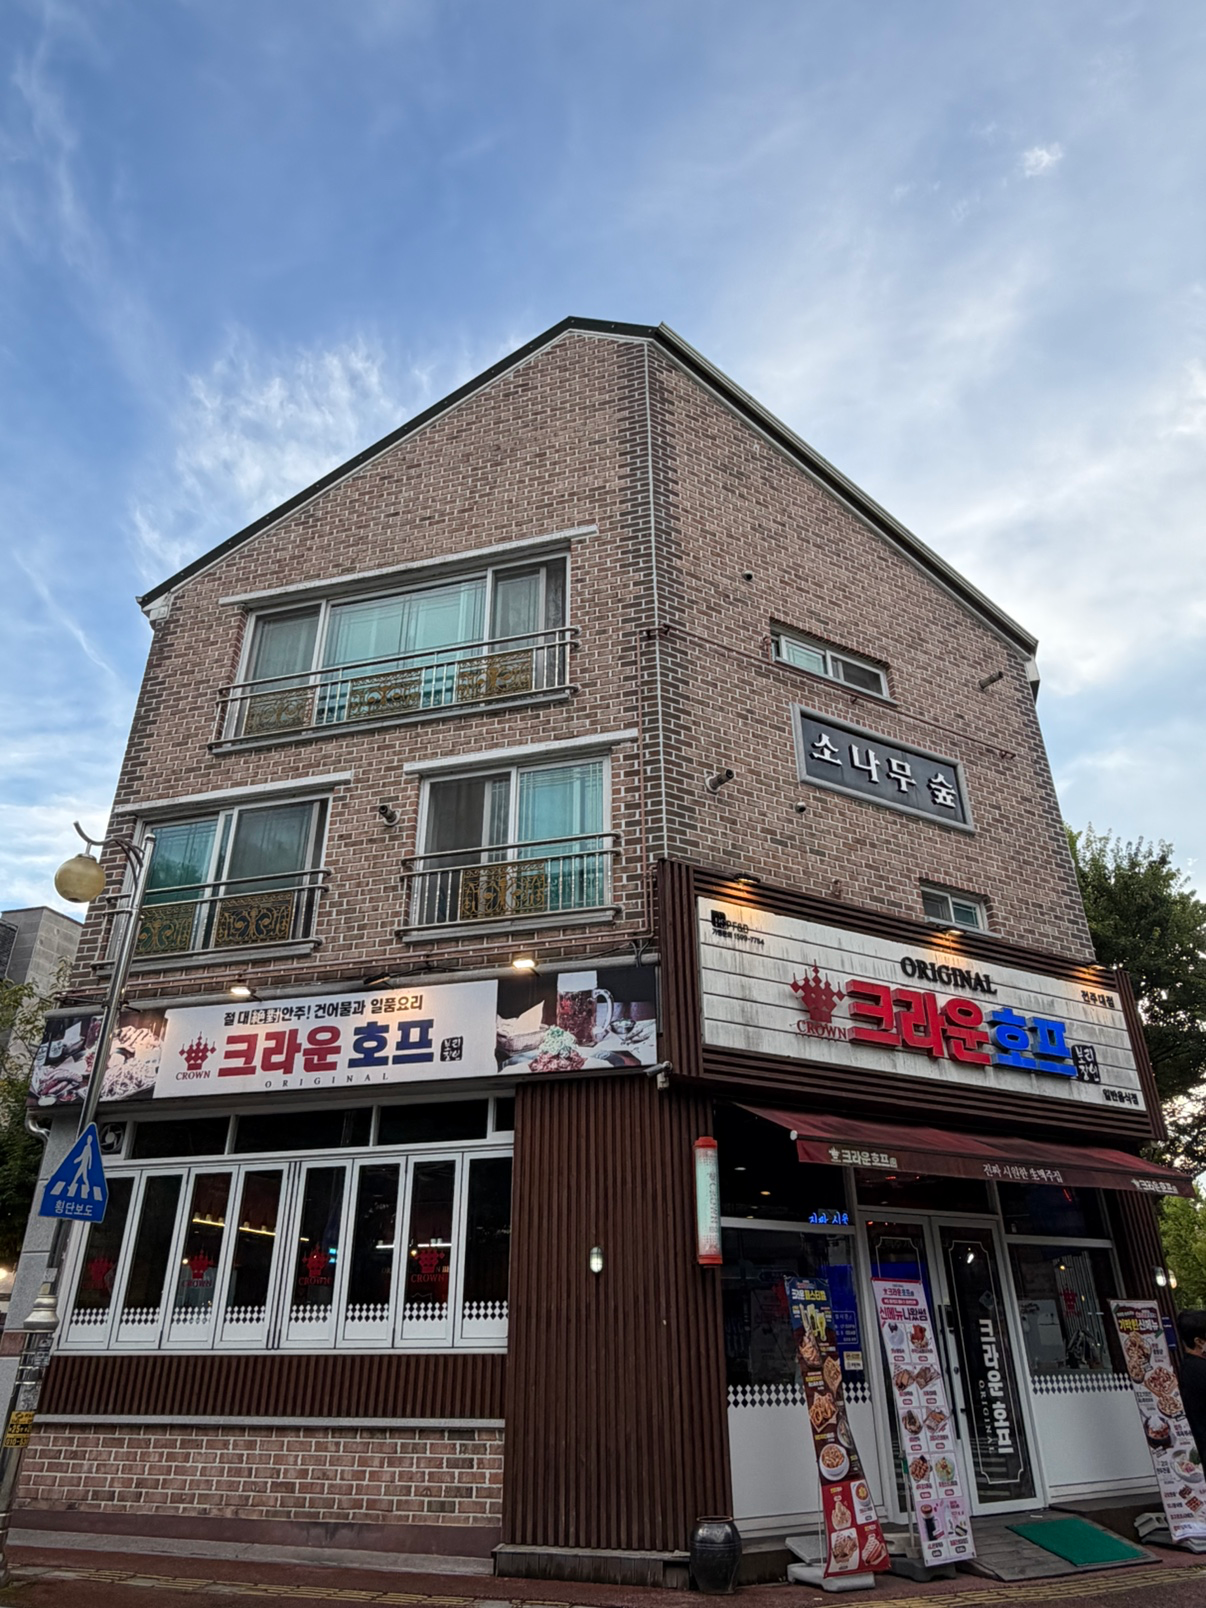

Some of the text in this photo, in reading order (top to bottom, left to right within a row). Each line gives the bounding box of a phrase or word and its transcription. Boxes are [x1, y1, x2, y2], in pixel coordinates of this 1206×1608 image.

[900, 956, 997, 995] ORIGINAL
[314, 1000, 366, 1019] 건어물과
[370, 994, 423, 1014] 일품요리
[1081, 990, 1116, 1009] 전주대점
[797, 1019, 848, 1042] CROWN
[175, 1070, 211, 1081] CROWN
[264, 1072, 389, 1089] ORIGINAL
[1102, 1088, 1140, 1106] 일반음식점
[841, 1149, 891, 1168] 크라운호프
[982, 1163, 1002, 1178] 진짜
[1003, 1165, 1029, 1180] 시원한
[55, 1199, 93, 1216] 횡단보도
[410, 1273, 446, 1284] CROWN
[978, 1379, 996, 1454] ORIGINAL
